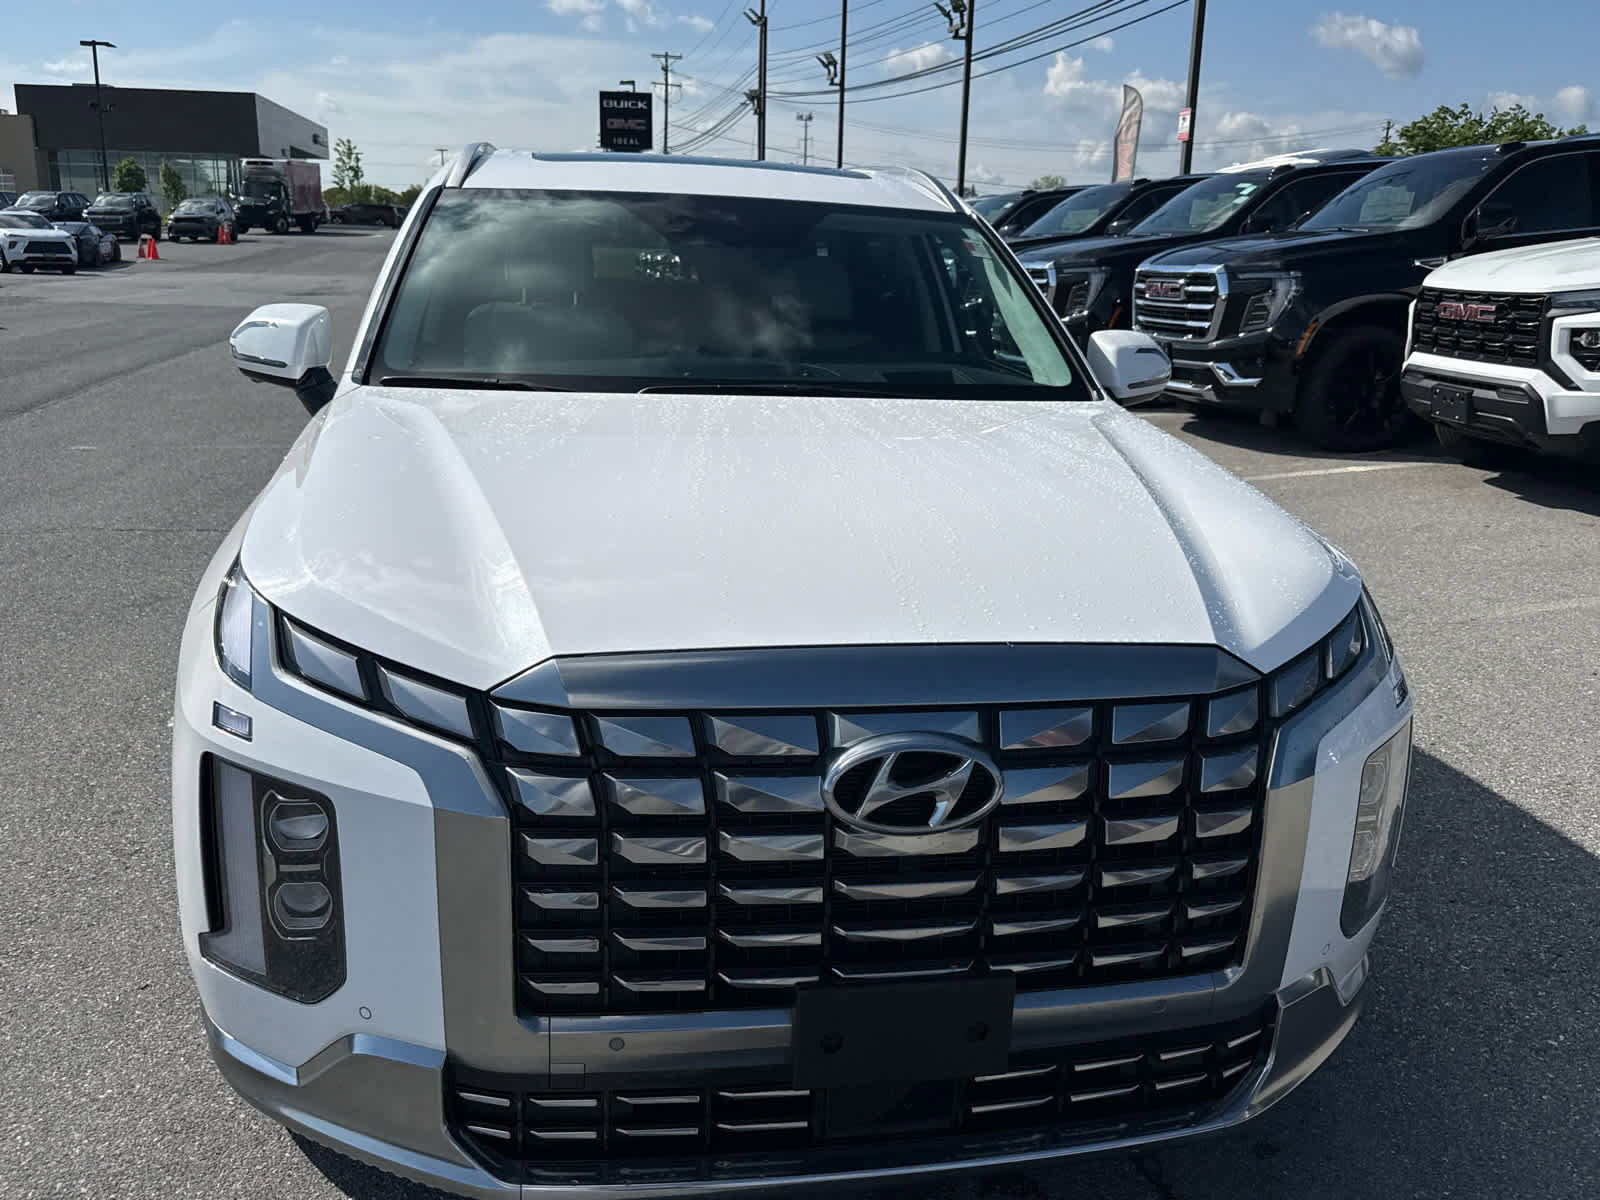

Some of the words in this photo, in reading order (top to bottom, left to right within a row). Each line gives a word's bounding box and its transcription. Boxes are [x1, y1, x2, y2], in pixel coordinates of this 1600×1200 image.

[603, 99, 648, 109] BUICK
[1145, 282, 1181, 298] GMC
[1438, 302, 1496, 322] GMC
